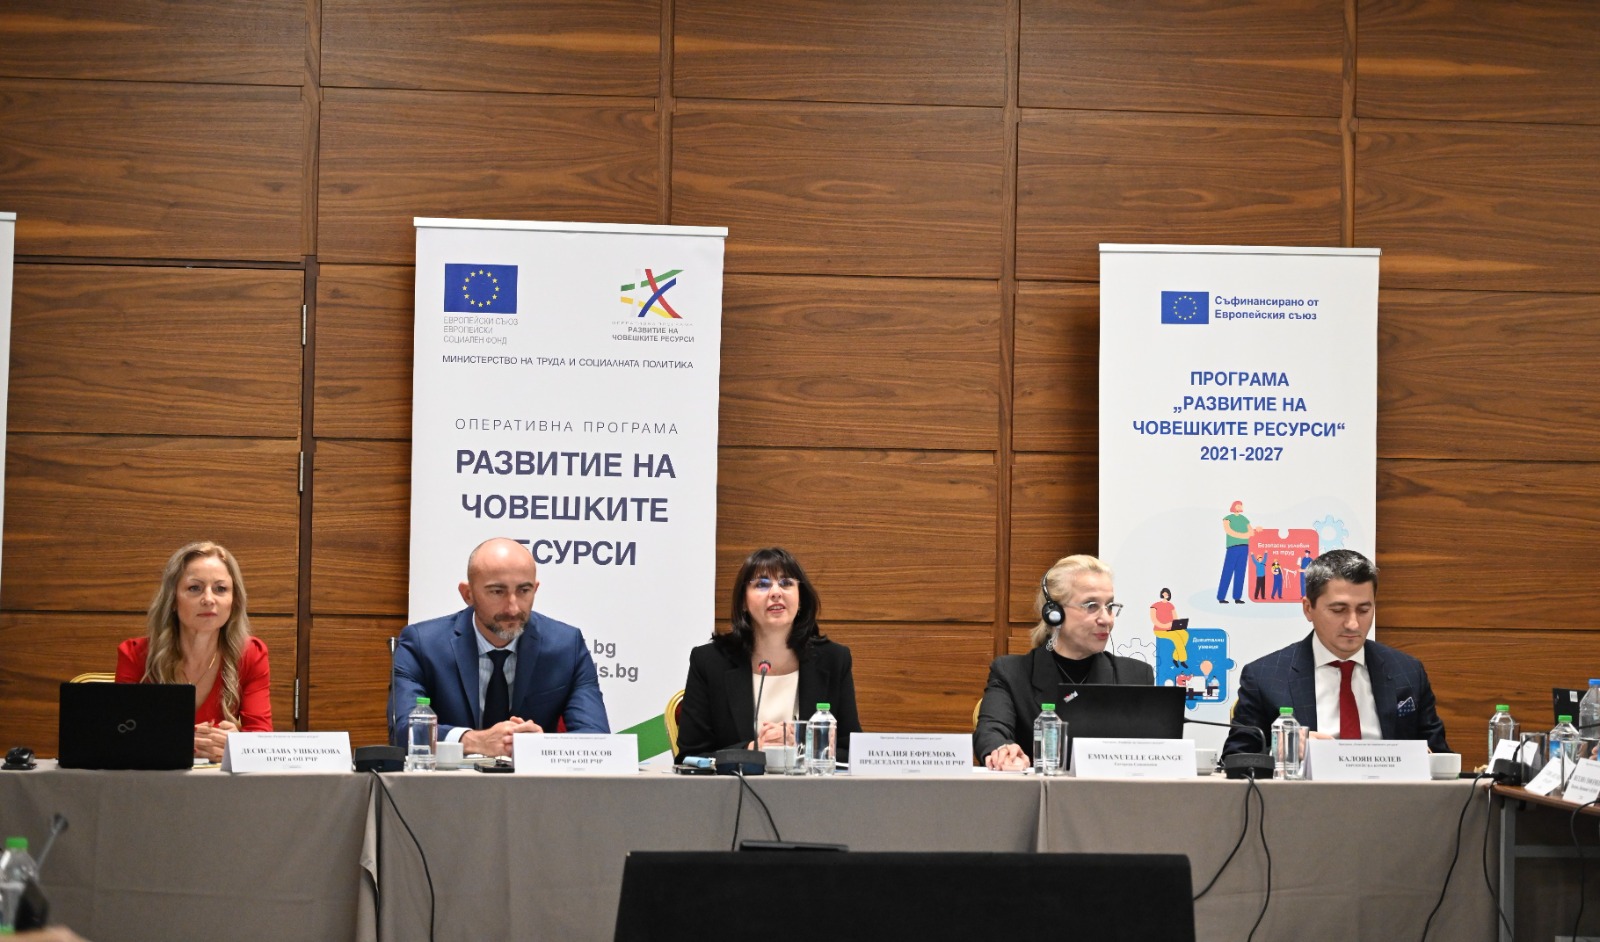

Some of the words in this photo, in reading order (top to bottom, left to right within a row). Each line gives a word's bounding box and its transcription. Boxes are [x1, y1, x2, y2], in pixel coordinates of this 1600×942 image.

[1214, 296, 1304, 307] Съфинансирано
[444, 316, 494, 325] ЕВРОПЕЙСКИ
[1214, 308, 1286, 320] Европейския
[1288, 312, 1316, 320] съюз
[444, 336, 484, 344] СОЦИАЛЕН
[486, 337, 508, 346] ФОНД
[442, 354, 518, 364] МИНИСТЕРСТВО
[520, 356, 534, 366] НА
[536, 356, 566, 366] ТРУДА
[568, 358, 576, 366] И
[578, 358, 640, 368] СОЦИАЛНАТА
[642, 360, 694, 368] ПОЛИТИКА
[1190, 372, 1290, 386] ПРОГРАМА
[1174, 396, 1278, 414] „РАЗВИТИЕ
[1282, 398, 1308, 412] НА
[456, 418, 574, 432] ОПЕРАТИВНА
[584, 422, 678, 434] ПРОГРАМА
[1132, 420, 1248, 436] ЧОВЕШКИТЕ
[1254, 422, 1346, 438] РЕСУРСИ“
[1200, 446, 1284, 462] 2021-2027
[456, 450, 622, 478] РАЗВИТИЕ
[634, 452, 676, 478] НА
[462, 494, 668, 522] ЧОВЕШКИТЕ
[515, 539, 637, 566] СУРСИ
